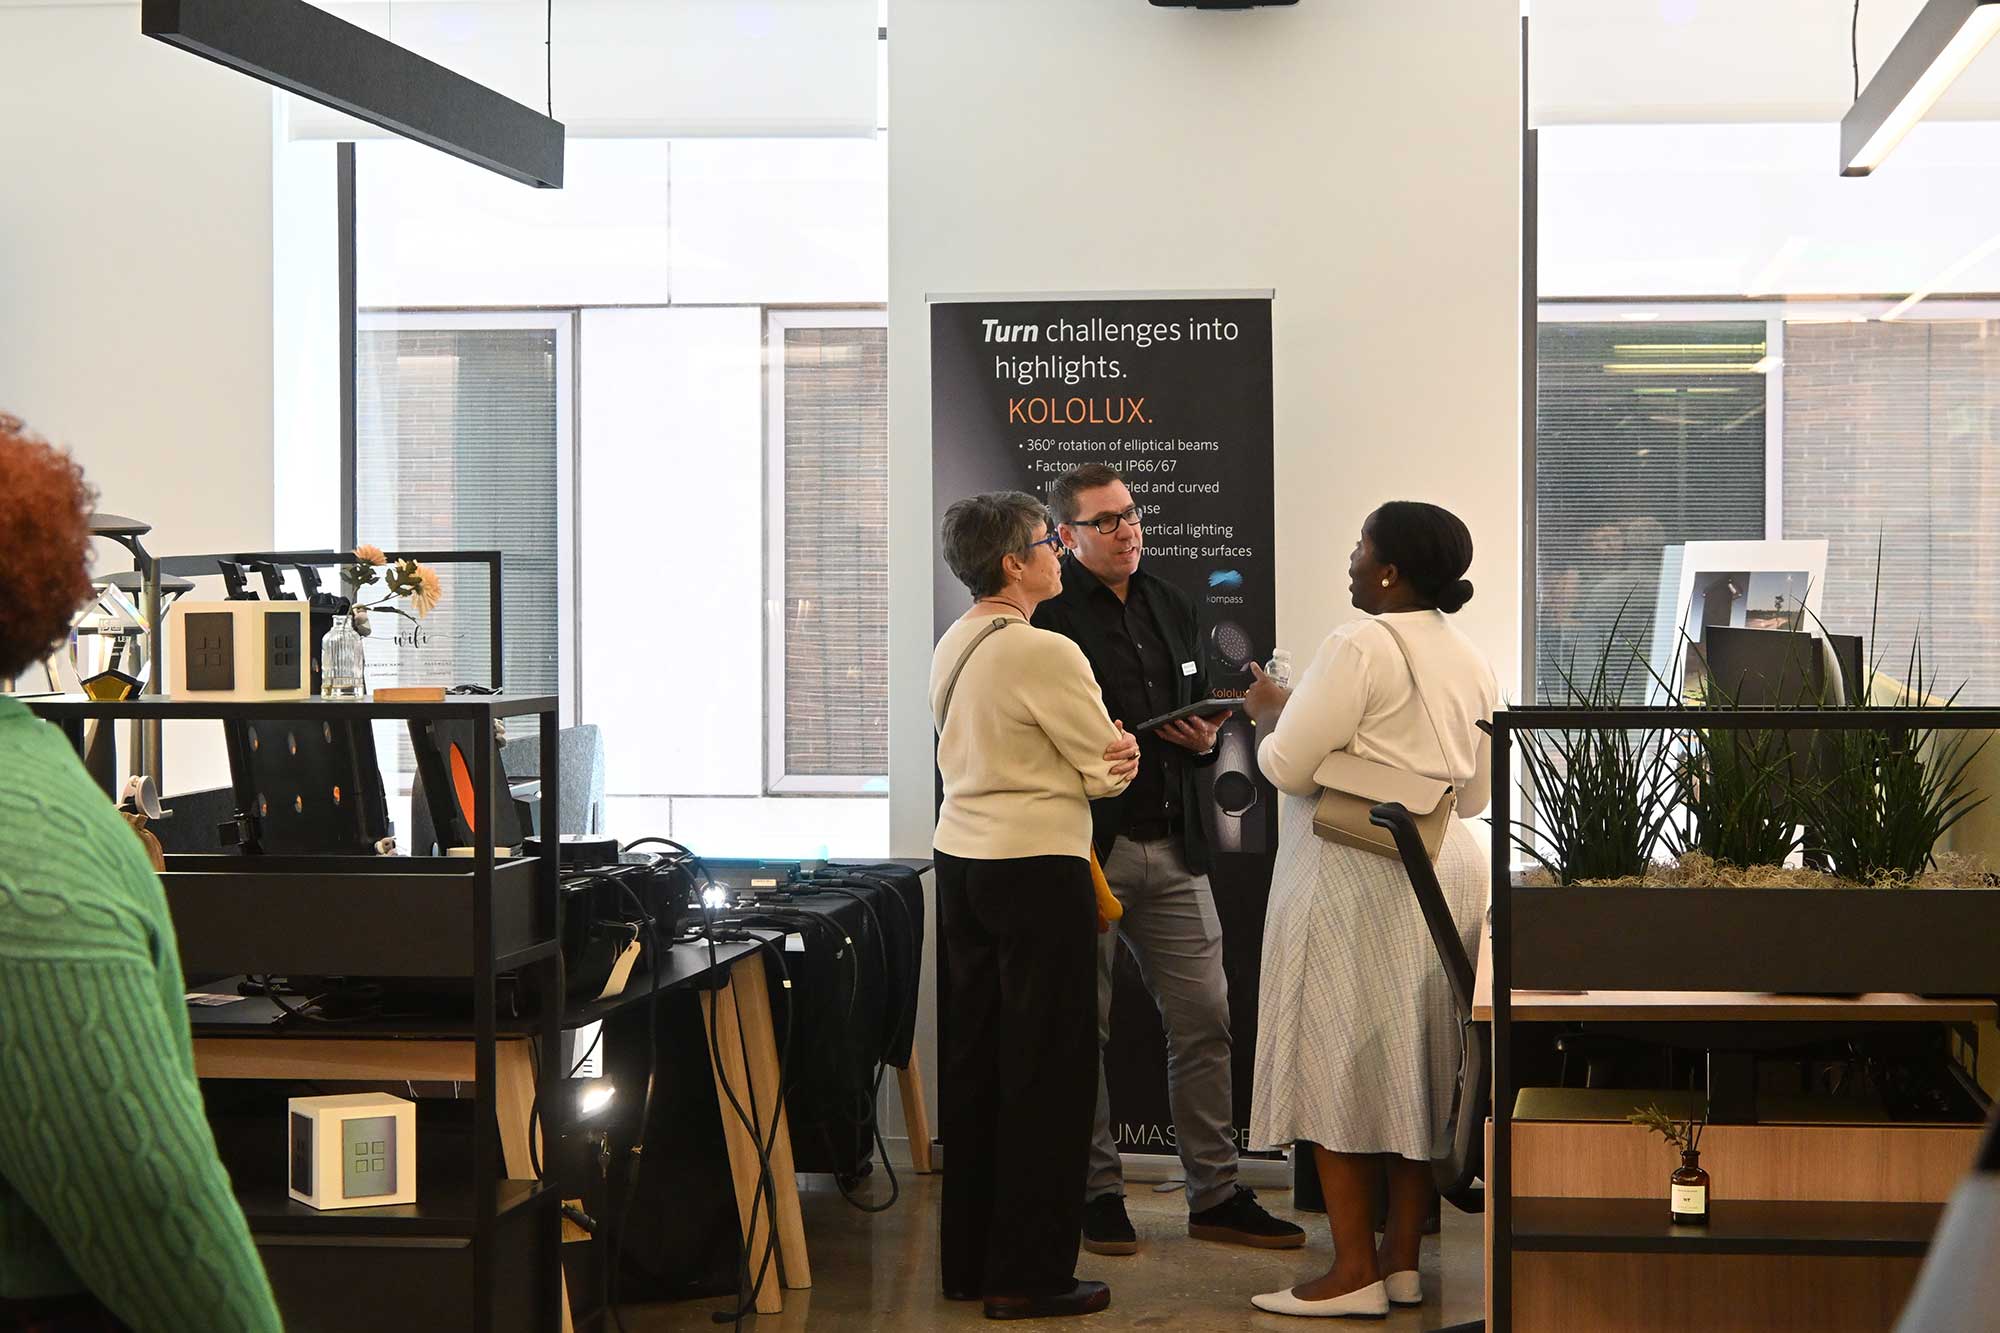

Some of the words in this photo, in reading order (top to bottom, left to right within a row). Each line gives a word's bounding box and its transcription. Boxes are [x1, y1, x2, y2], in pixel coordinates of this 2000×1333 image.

[982, 319, 1039, 342] Turn
[1046, 318, 1181, 347] challenges
[1189, 317, 1239, 341] into
[995, 355, 1128, 385] highlights.
[1009, 398, 1153, 424] KOLOLUX.
[1058, 439, 1107, 451] rotation
[1109, 439, 1123, 451] of
[1124, 439, 1175, 453] elliptical
[1178, 439, 1219, 451] beams
[1036, 460, 1081, 473] Factory
[1126, 460, 1177, 472] IP66/67
[1152, 481, 1175, 493] and
[1178, 481, 1220, 493] curved
[1186, 523, 1233, 538] lighting
[1142, 544, 1198, 559] mounting
[1201, 544, 1252, 557] surfaces
[1206, 594, 1244, 604] kompass
